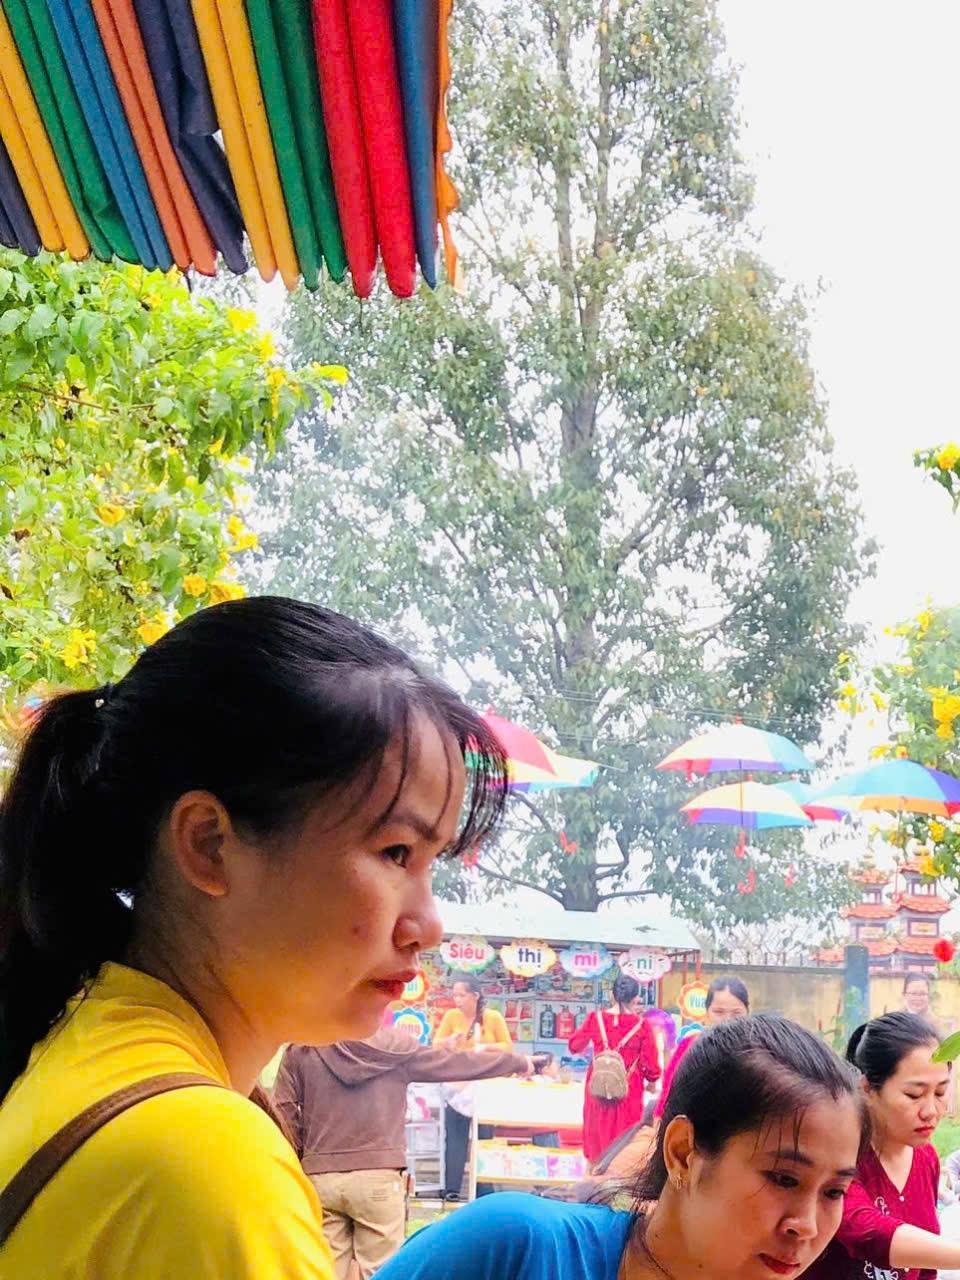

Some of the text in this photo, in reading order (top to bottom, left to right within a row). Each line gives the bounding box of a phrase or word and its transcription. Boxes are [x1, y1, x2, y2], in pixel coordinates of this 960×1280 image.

[518, 947, 541, 968] thị
[575, 951, 597, 967] mi
[637, 953, 652, 970] ni
